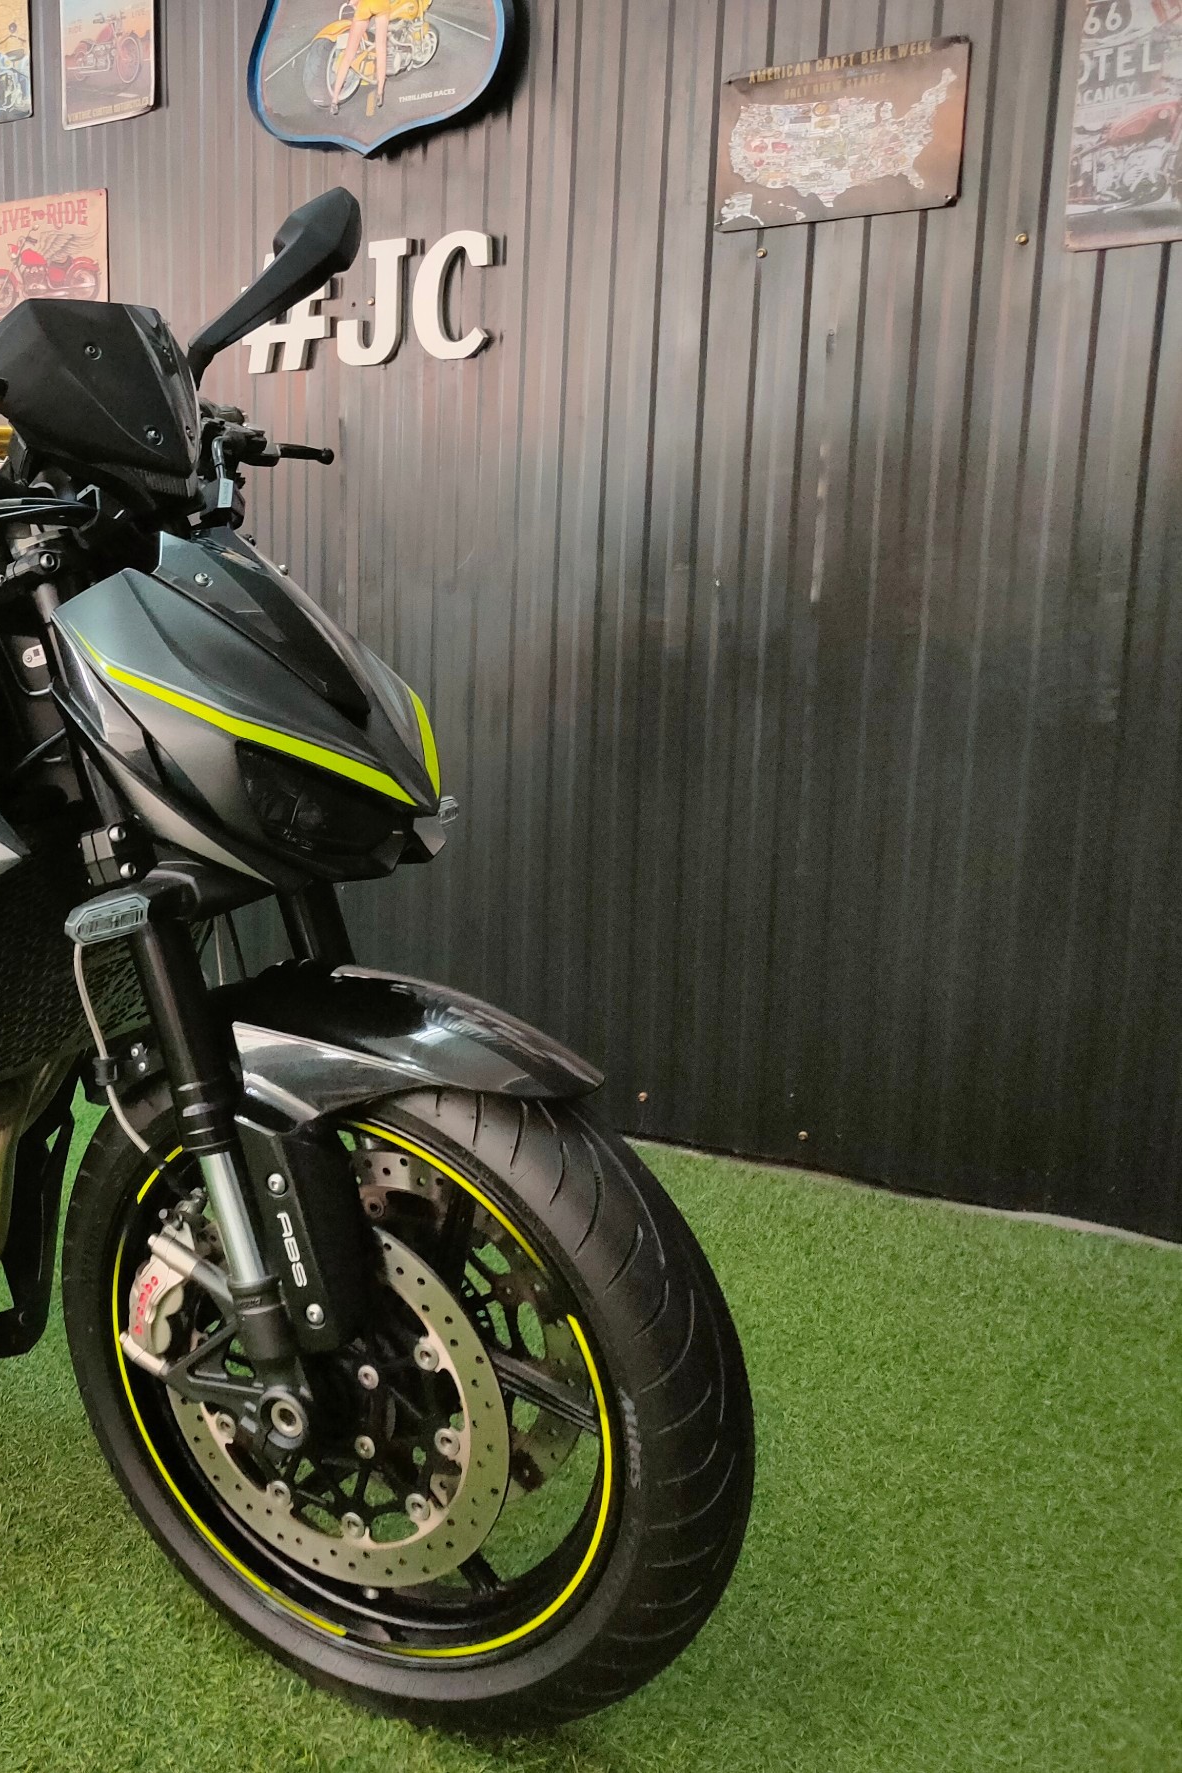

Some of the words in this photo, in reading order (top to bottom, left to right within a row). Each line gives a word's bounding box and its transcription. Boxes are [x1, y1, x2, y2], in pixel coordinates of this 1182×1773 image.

[1083, 2, 1123, 35] 66
[748, 62, 811, 84] AMERICAN
[815, 53, 855, 72] CRAFT
[861, 46, 891, 64] BEER
[897, 39, 932, 58] WEEK
[398, 92, 433, 103] THRILLING
[433, 88, 456, 97] RACES
[31, 209, 45, 221] TO
[46, 199, 88, 230] RIDE
[276, 1211, 308, 1288] ABS
